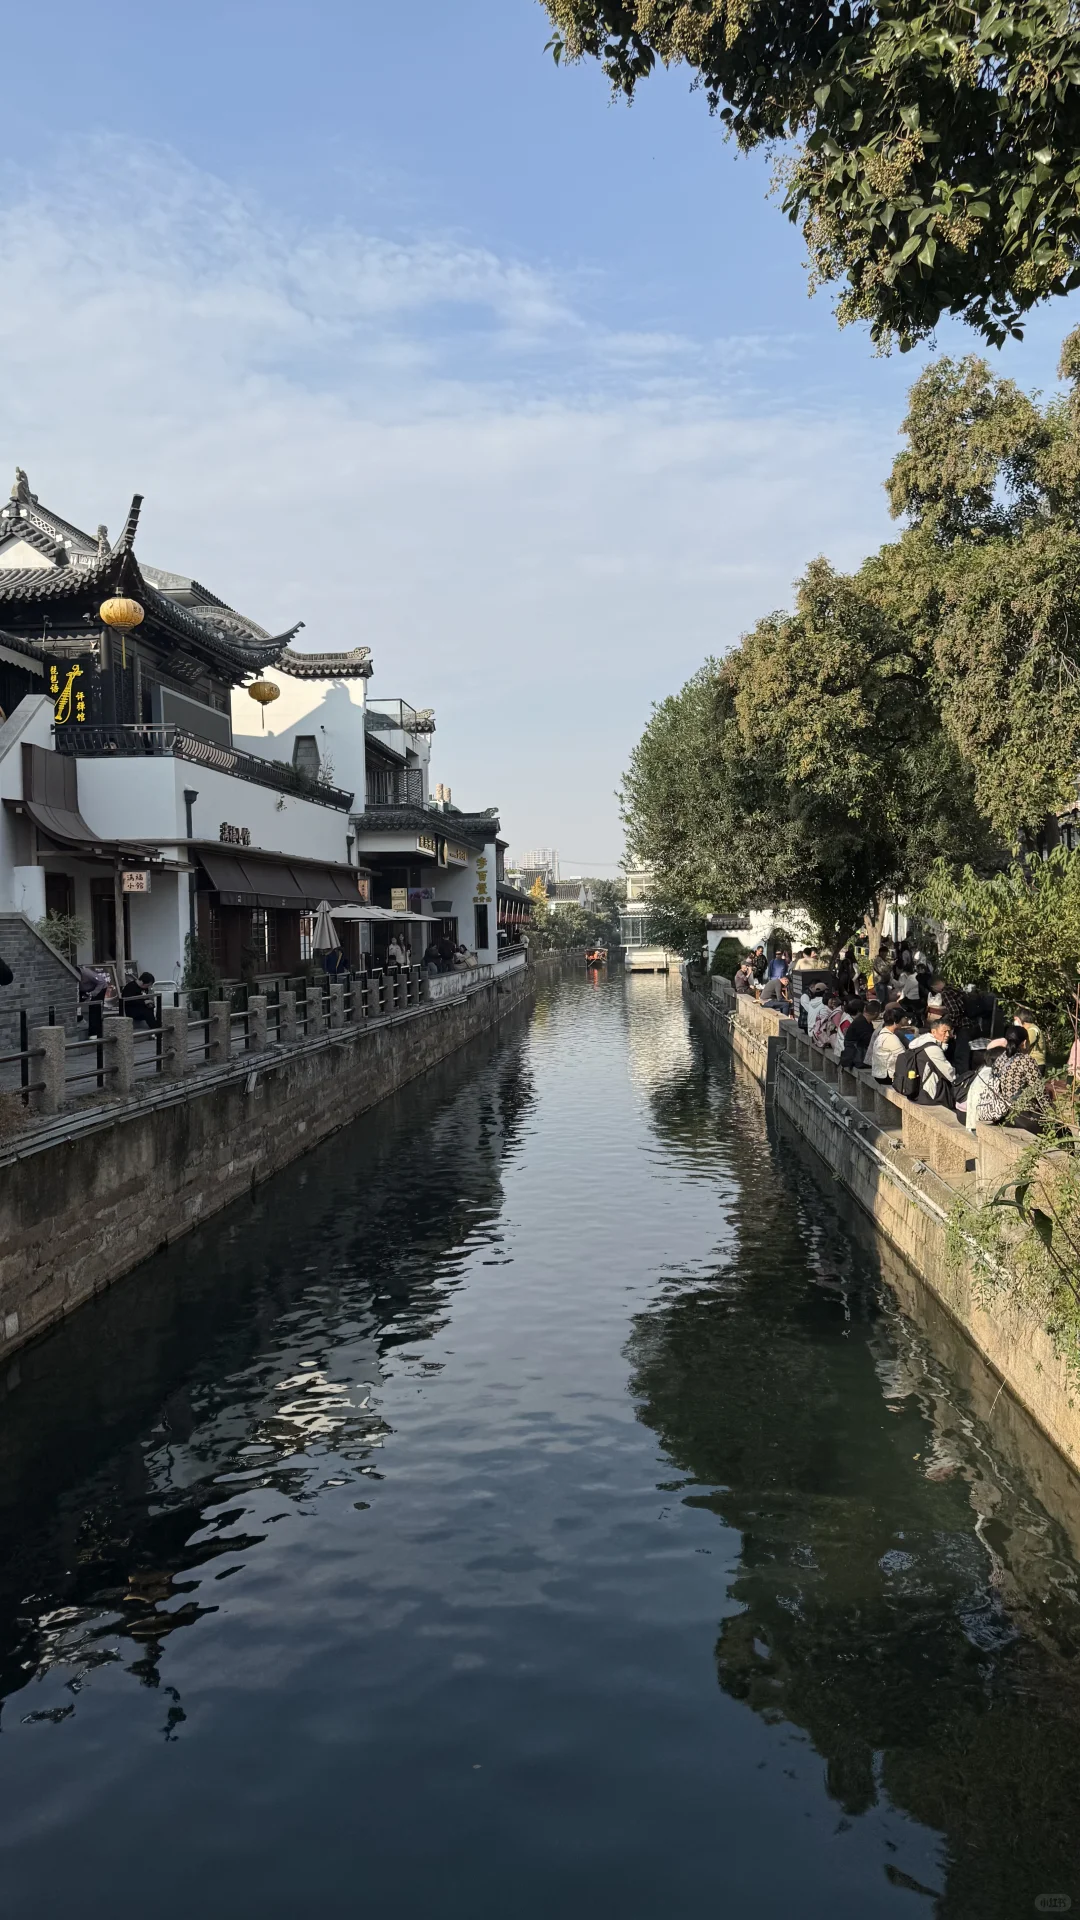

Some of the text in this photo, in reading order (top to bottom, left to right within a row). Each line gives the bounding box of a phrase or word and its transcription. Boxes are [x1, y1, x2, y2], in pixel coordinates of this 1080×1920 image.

[50, 665, 59, 694] 琵琶语
[126, 873, 144, 882] 满福
[127, 882, 144, 890] 小馆
